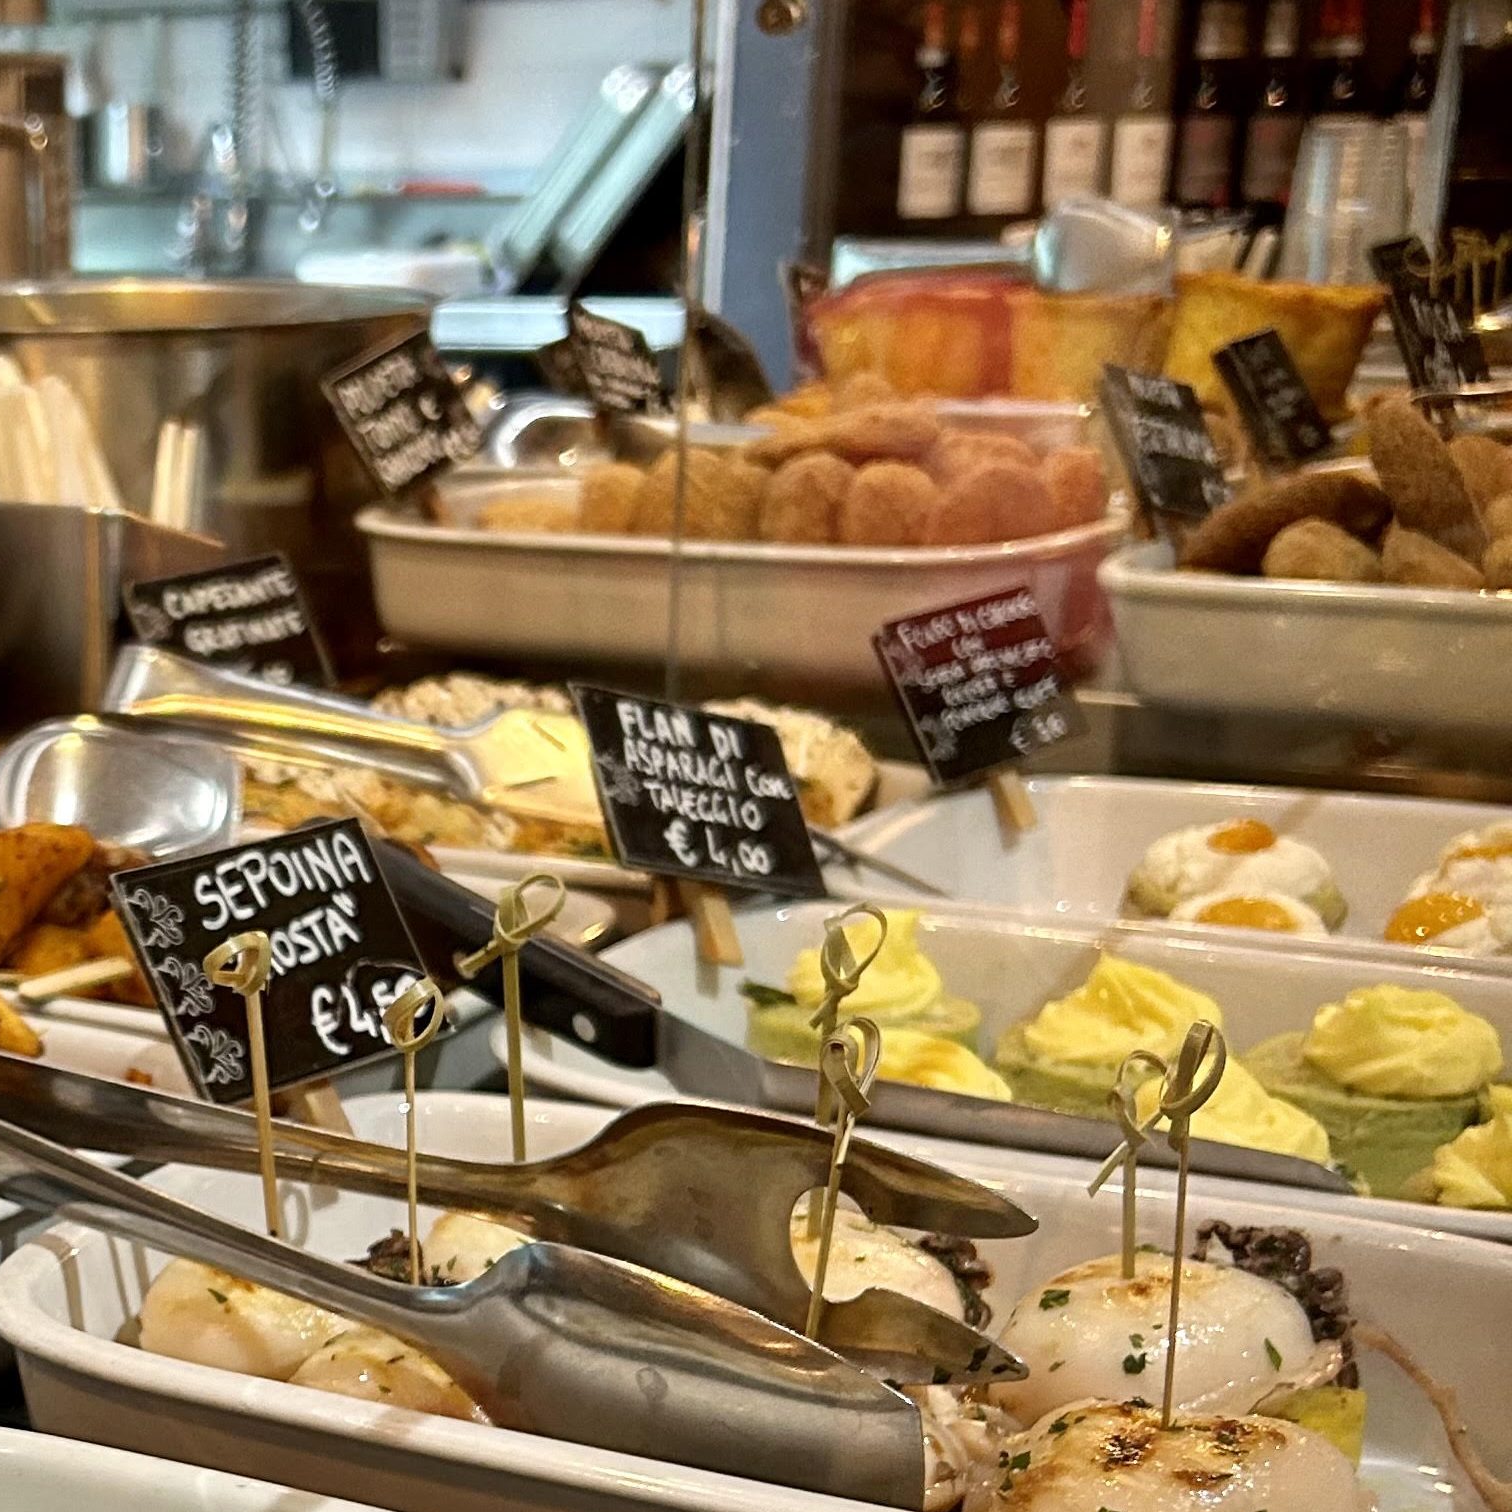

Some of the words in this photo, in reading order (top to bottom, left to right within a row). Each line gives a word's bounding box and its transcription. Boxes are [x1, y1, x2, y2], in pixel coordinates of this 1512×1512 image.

[616, 701, 696, 748] FLAN
[708, 722, 743, 761] DI
[623, 736, 737, 791] ASPARAGI
[643, 779, 766, 831] TALEGGIO
